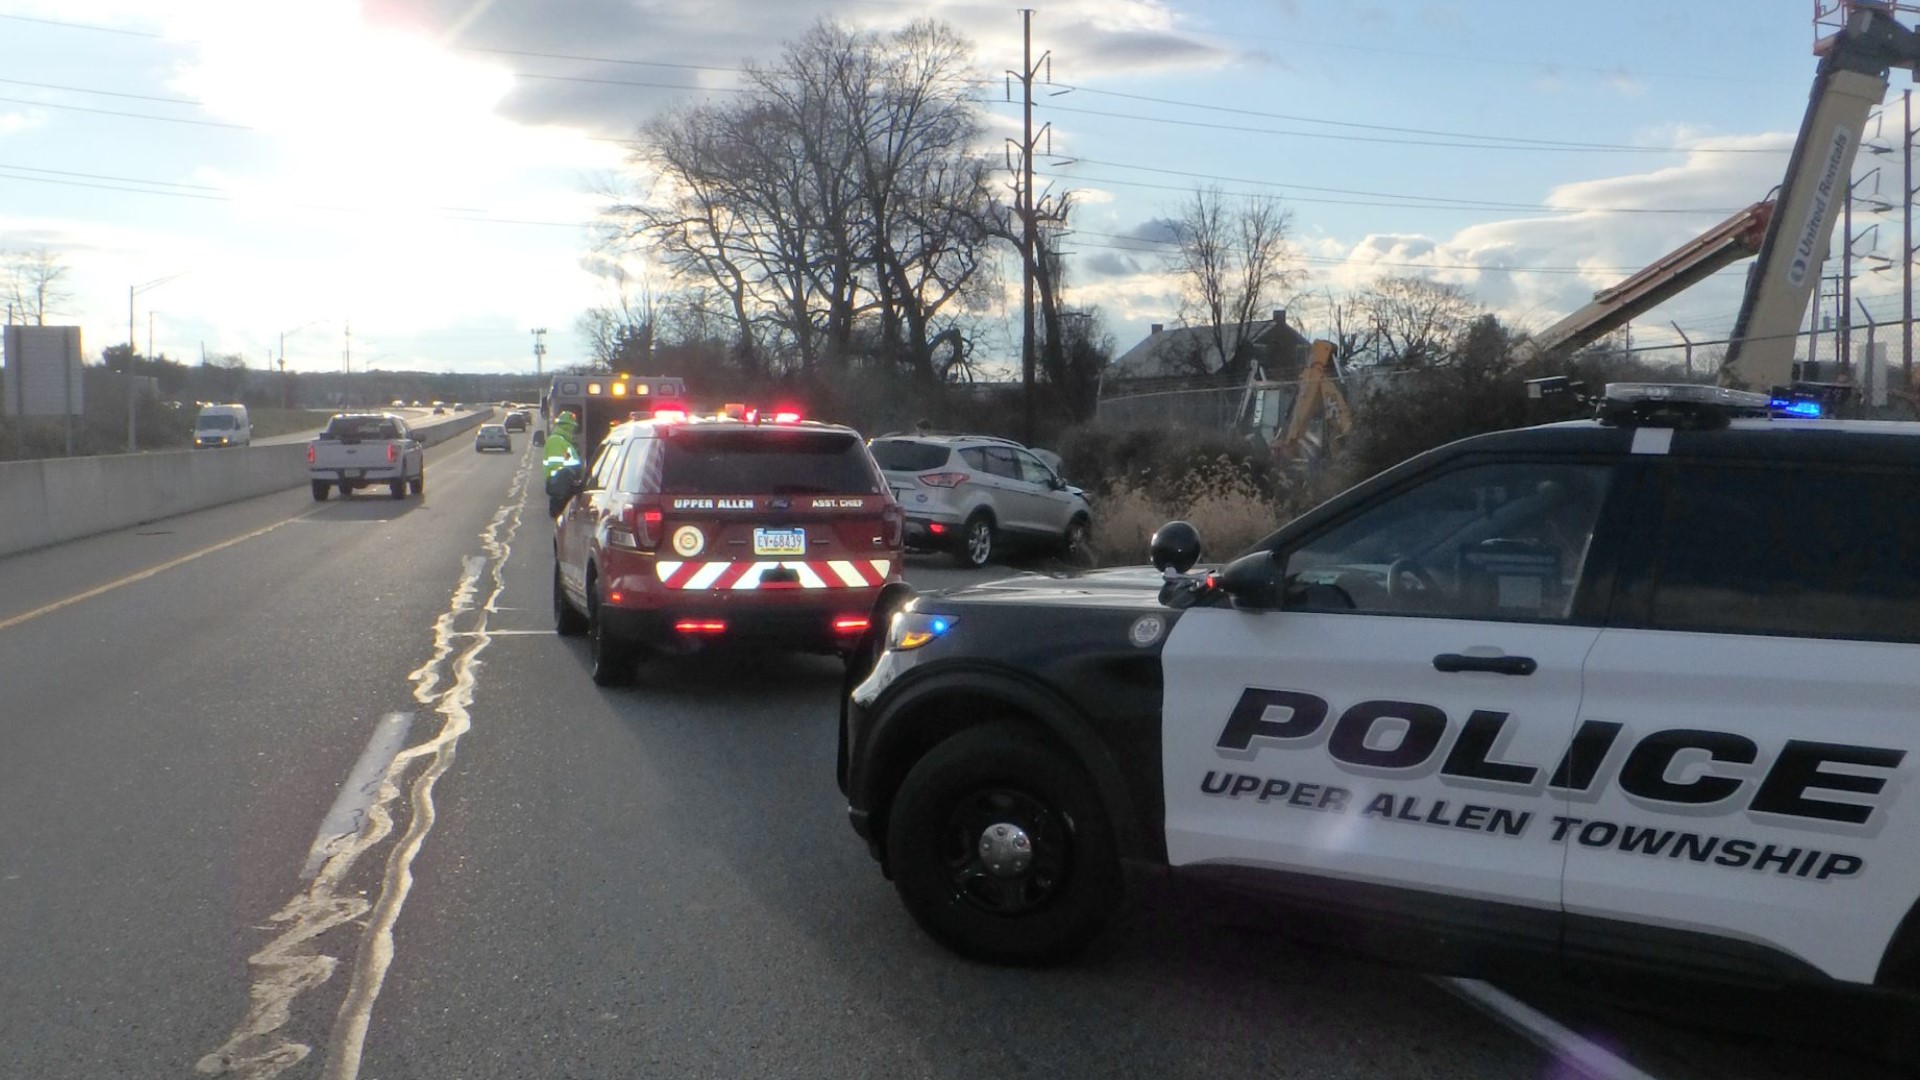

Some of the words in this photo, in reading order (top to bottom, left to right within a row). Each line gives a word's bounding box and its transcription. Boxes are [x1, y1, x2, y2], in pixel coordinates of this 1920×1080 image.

[1799, 196, 1826, 257] United
[1819, 133, 1847, 197] Rentals
[674, 499, 713, 509] UPPER
[717, 499, 753, 509] ALLEN
[812, 499, 838, 508] ASST.
[839, 499, 863, 508] CHIEF
[1216, 686, 1908, 828] POLICE
[1200, 770, 1353, 813] UPPER
[1363, 792, 1532, 837] ALLEN
[1551, 815, 1864, 881] TOWNSHIP
